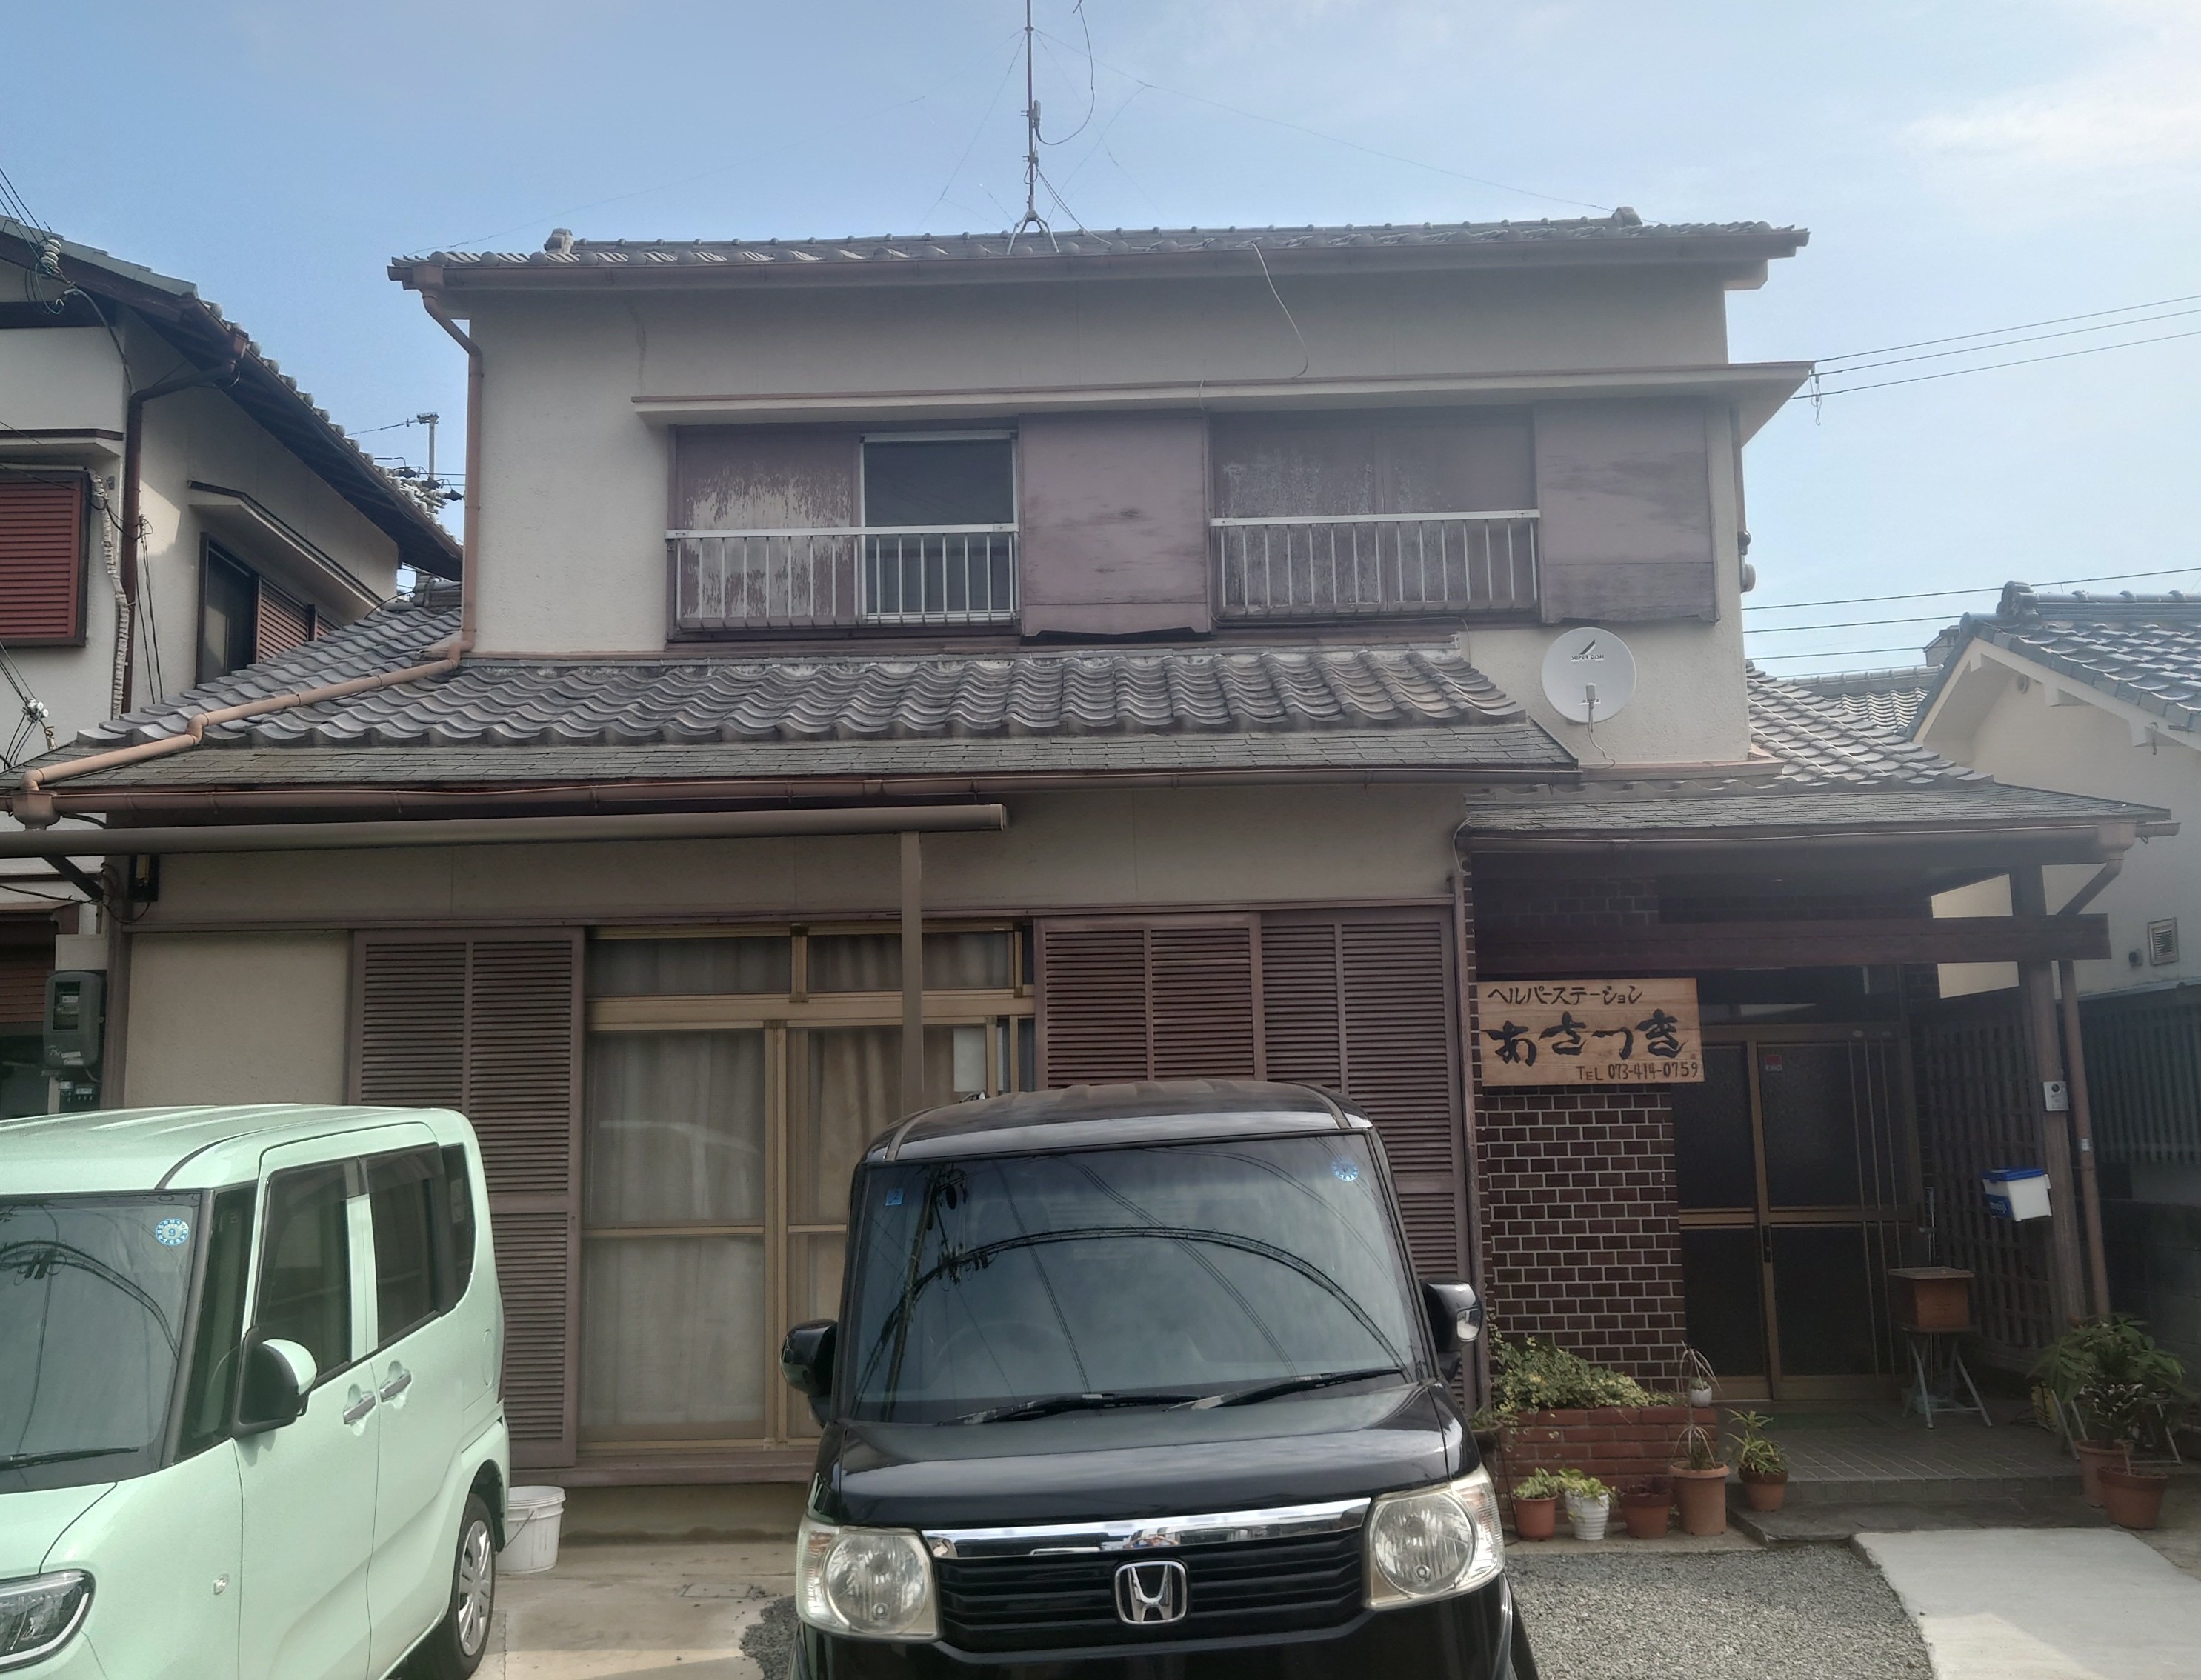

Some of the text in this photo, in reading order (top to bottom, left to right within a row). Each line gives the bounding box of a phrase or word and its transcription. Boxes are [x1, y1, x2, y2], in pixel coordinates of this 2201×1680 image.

[1487, 986, 1643, 1005] ヘルパーステーション
[1481, 1008, 1689, 1067] あさつき
[1608, 1062, 1698, 1081] 073-414-0759
